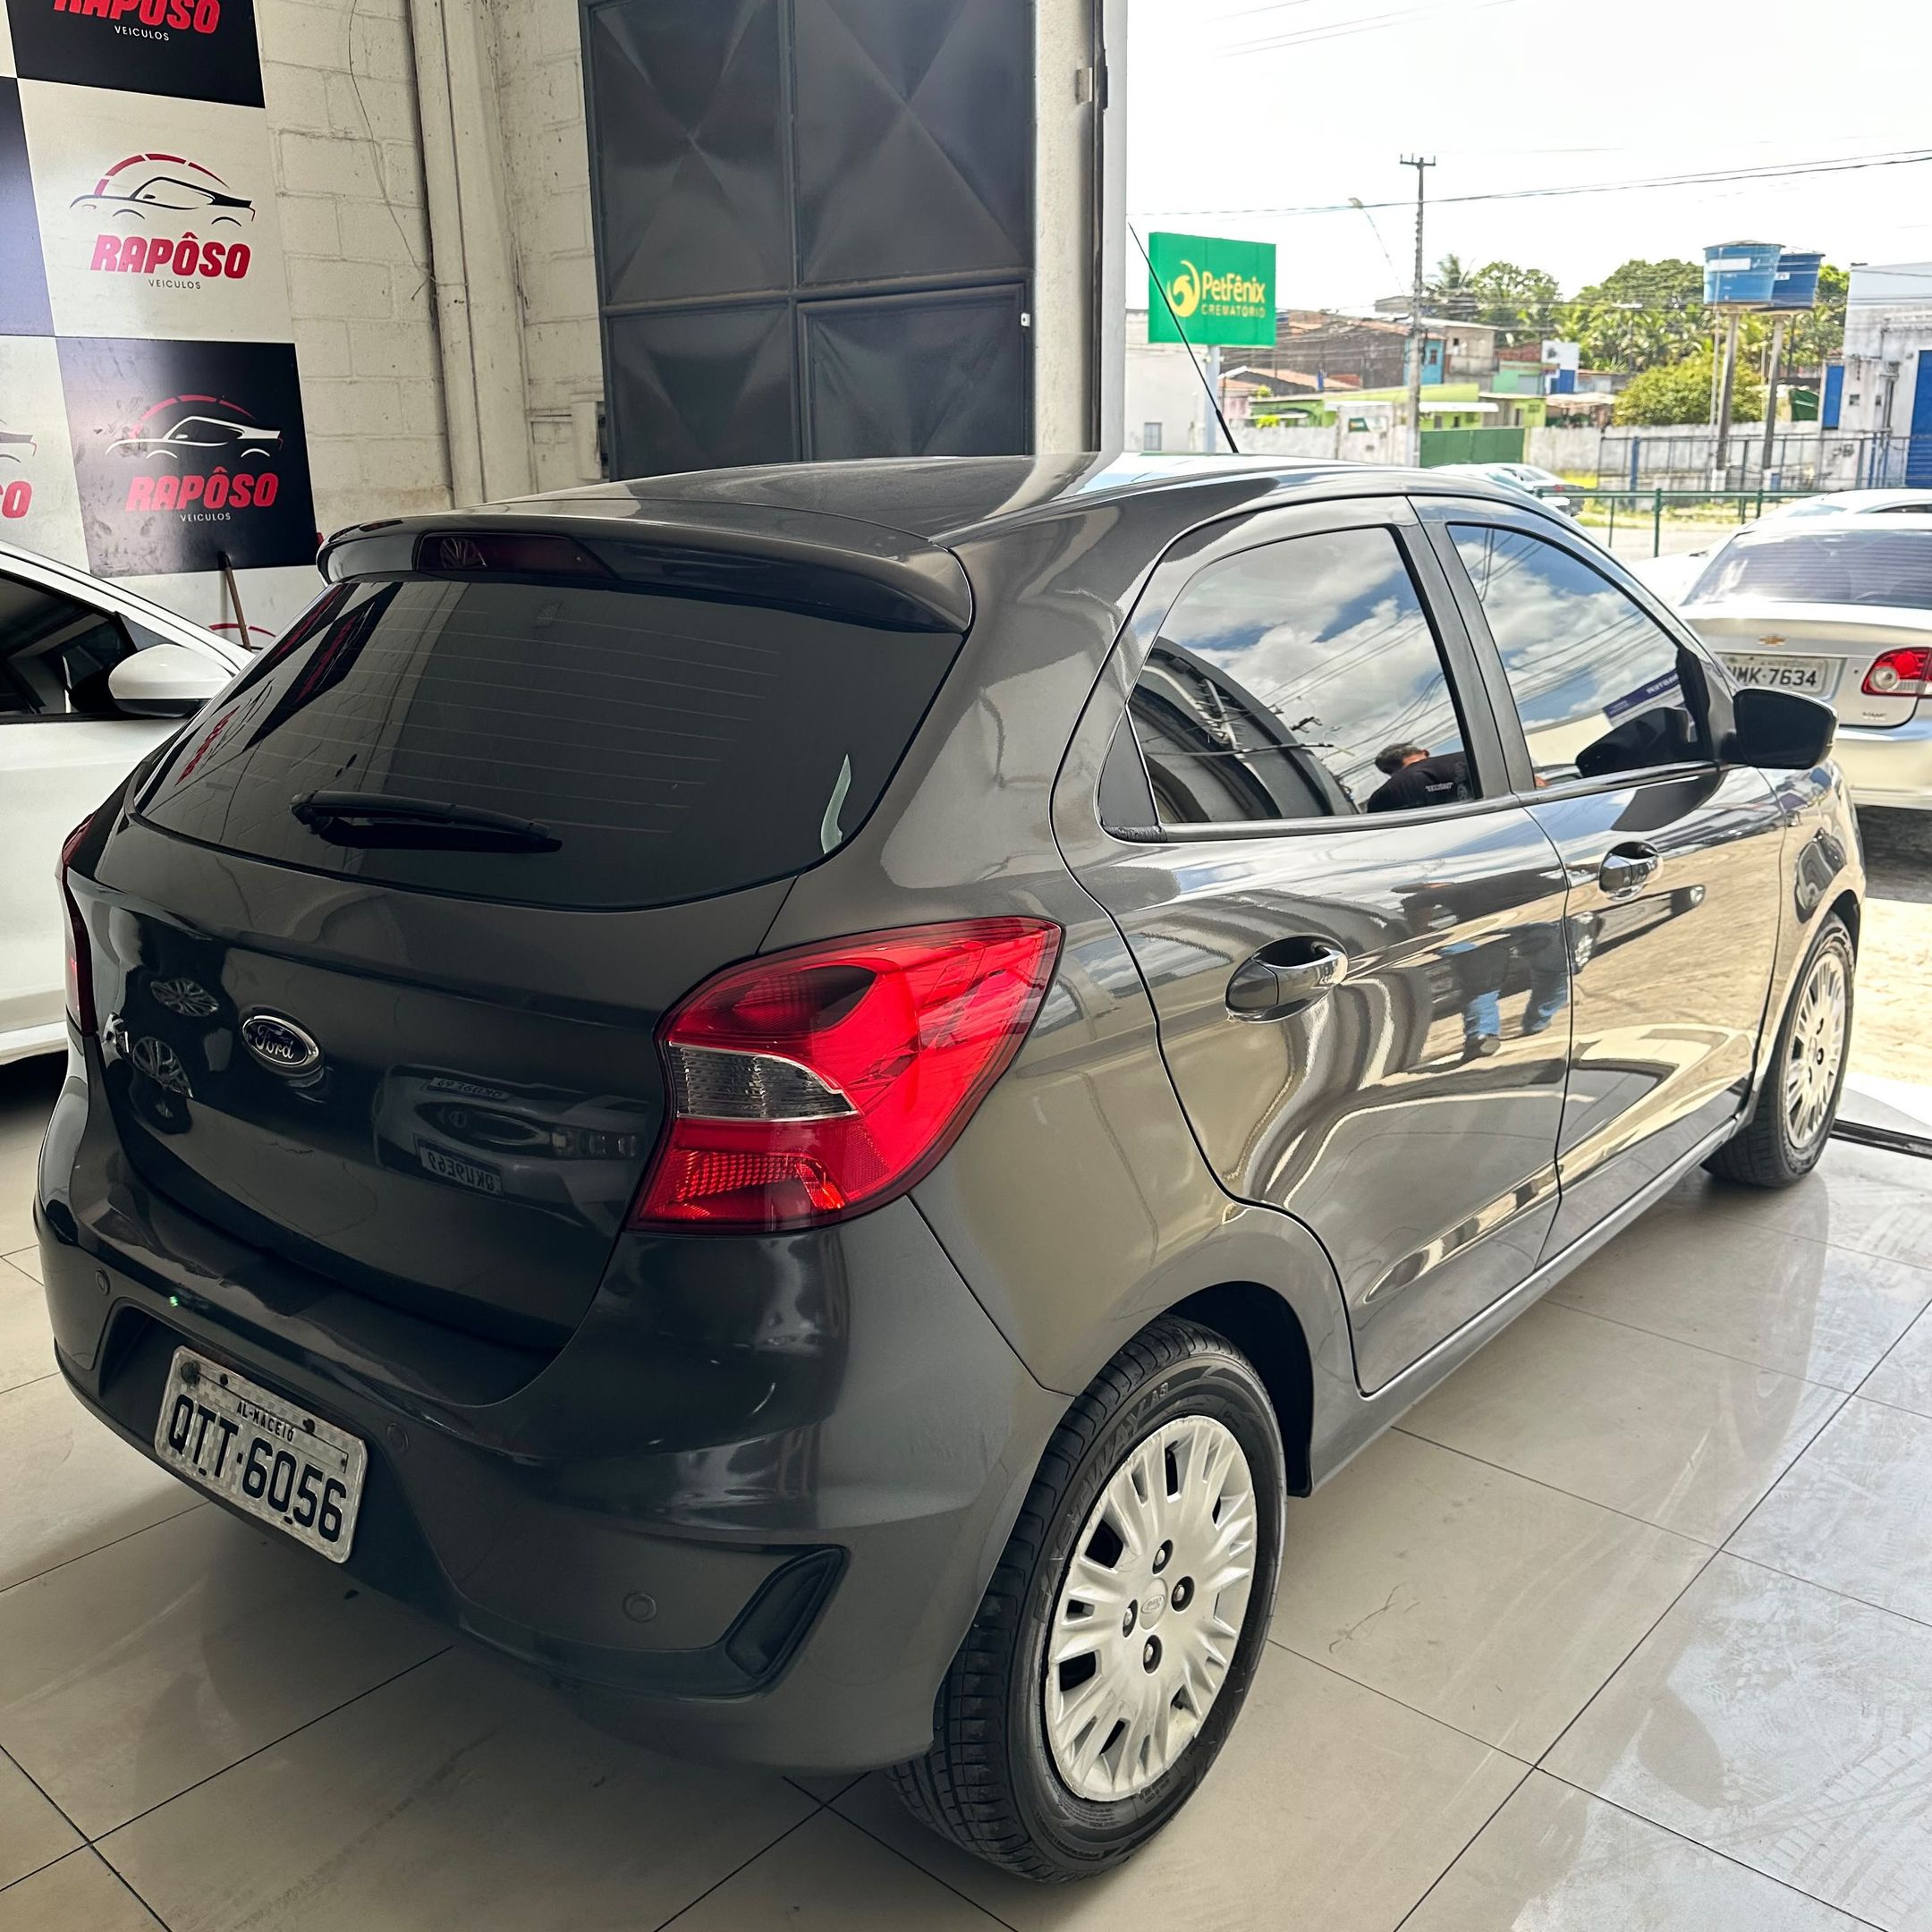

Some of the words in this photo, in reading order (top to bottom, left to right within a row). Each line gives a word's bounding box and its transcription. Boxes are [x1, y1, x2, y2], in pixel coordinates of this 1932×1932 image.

[114, 25, 170, 41] VEICULOS
[90, 231, 251, 279] RAPÔSO
[148, 279, 201, 290] VEICULOS
[1202, 271, 1266, 303] PetFênix
[125, 466, 279, 512] RAPÔSO
[180, 512, 231, 522] VEICULOS
[255, 1024, 294, 1059] Ford
